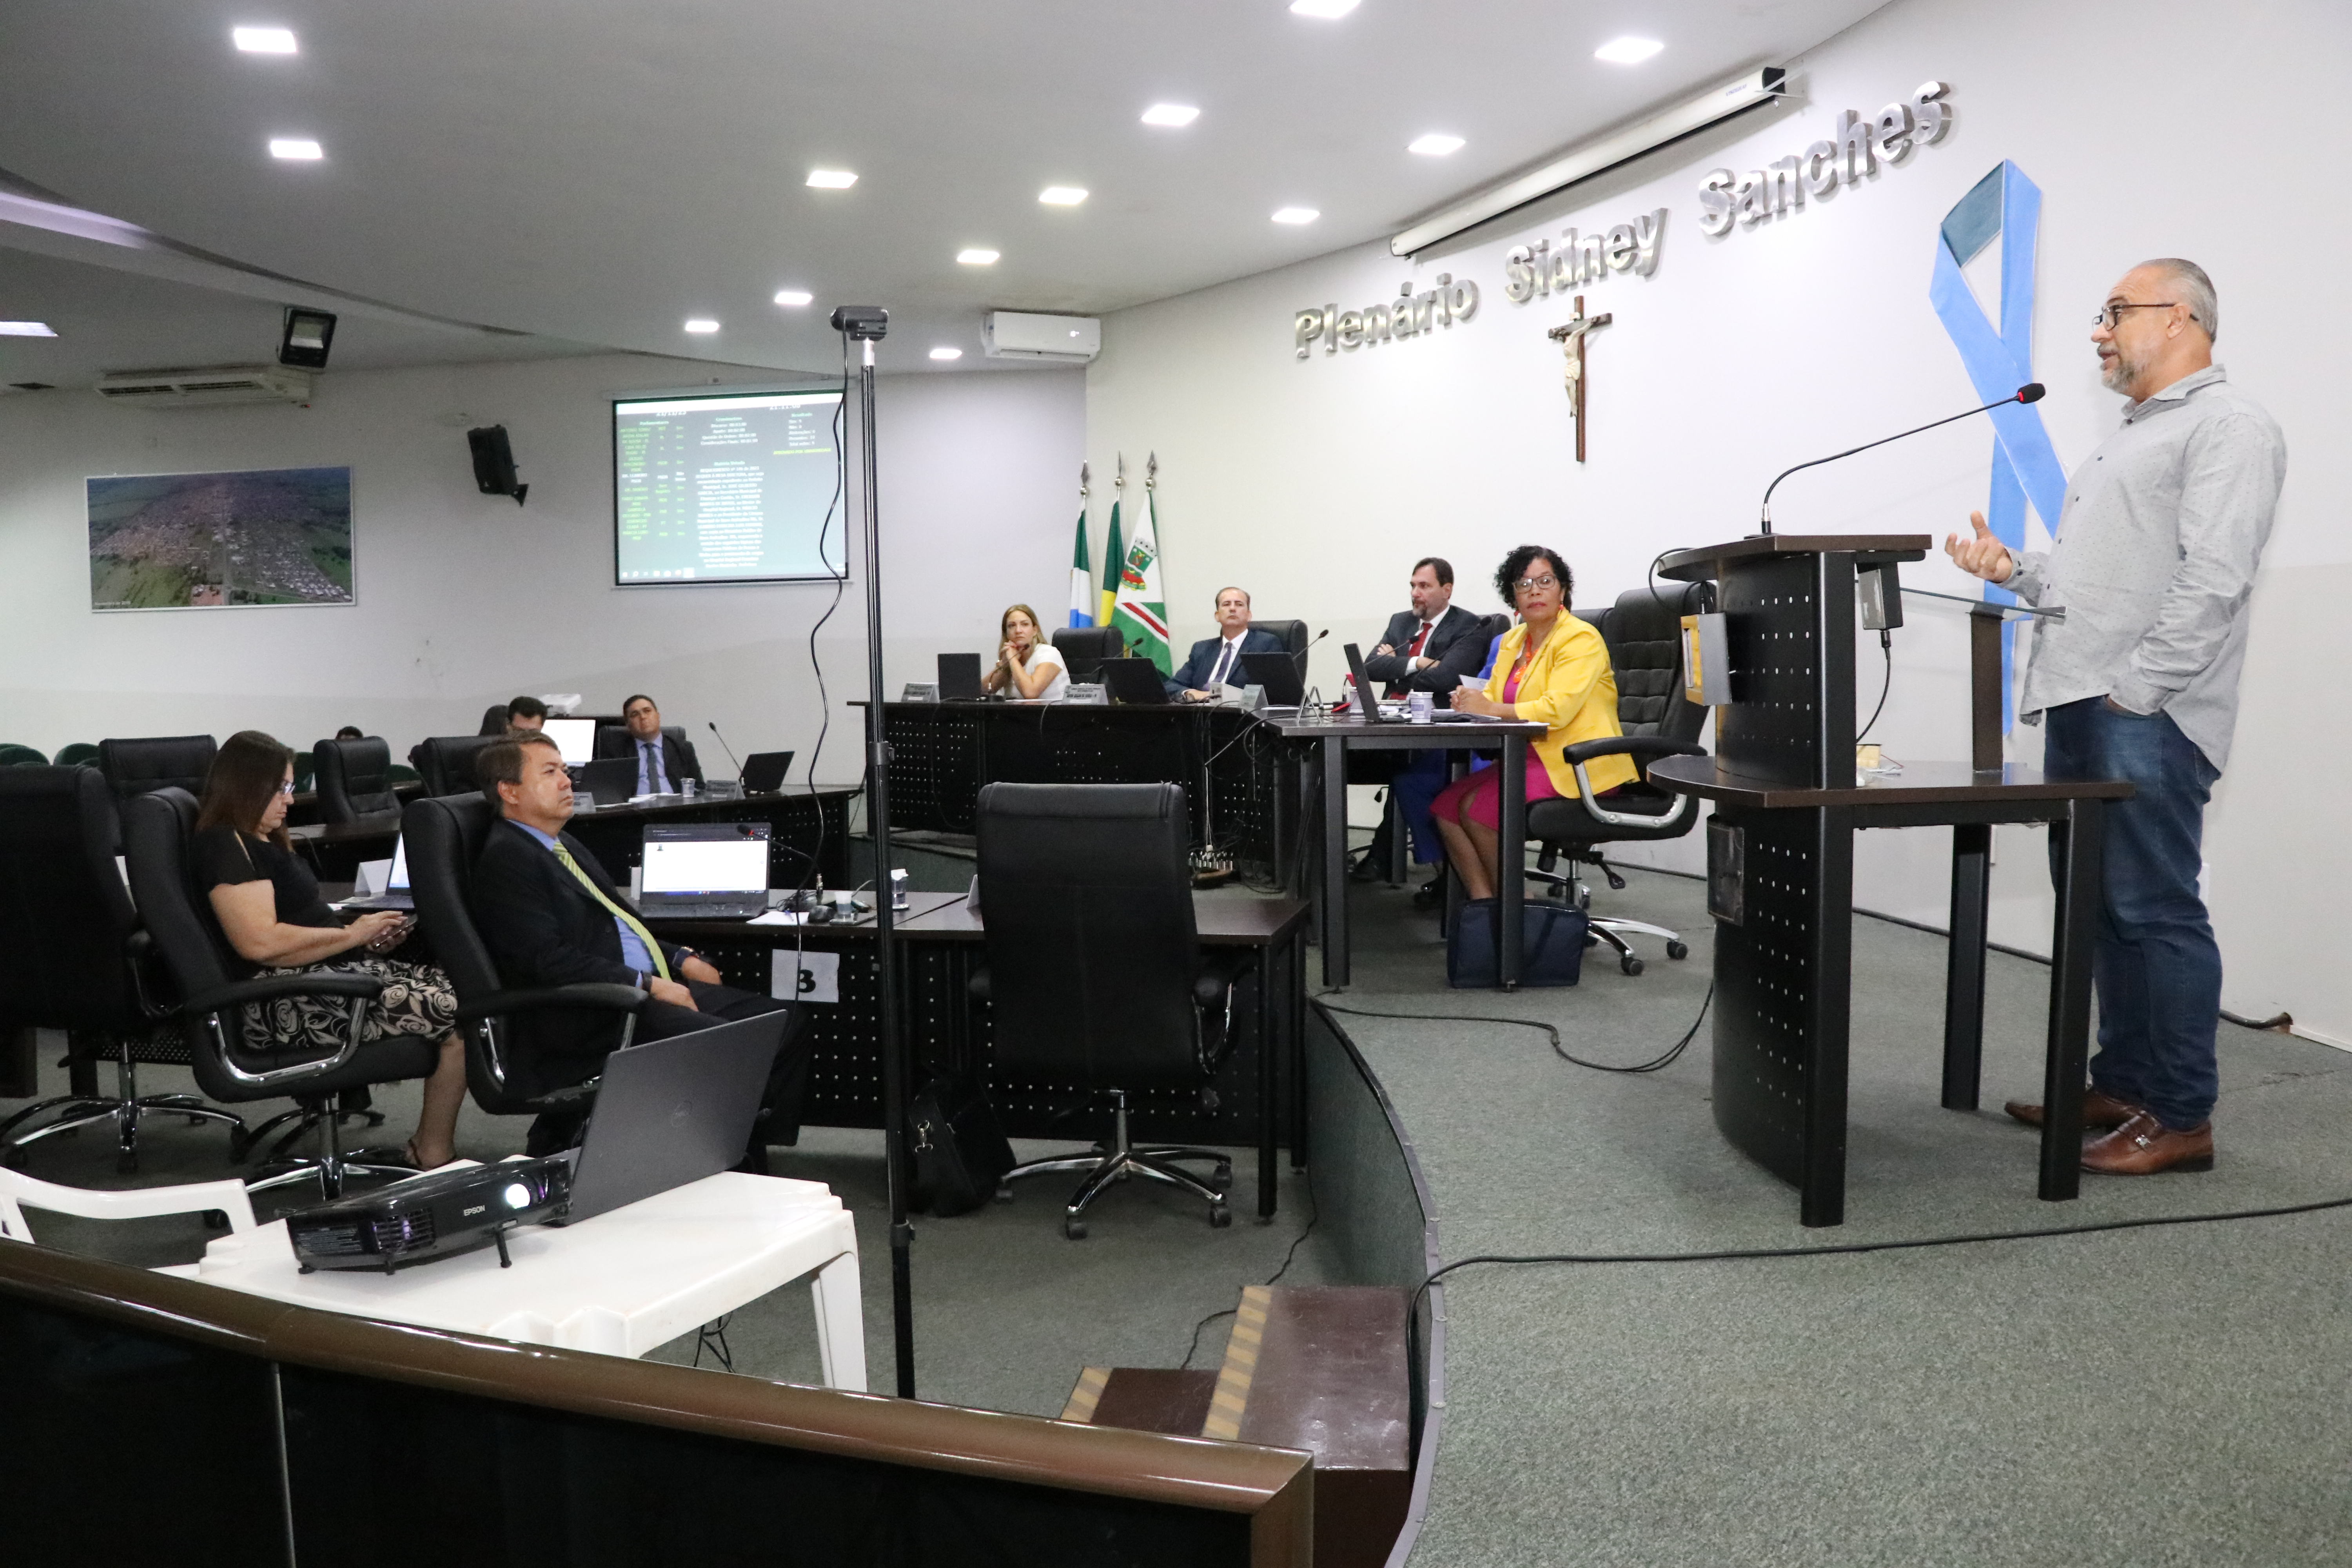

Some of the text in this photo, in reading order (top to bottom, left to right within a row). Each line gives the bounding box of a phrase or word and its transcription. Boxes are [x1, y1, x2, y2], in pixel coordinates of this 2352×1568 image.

[1295, 80, 1953, 359] Plenário Sidney Sanches
[463, 1205, 485, 1216] EPSON
